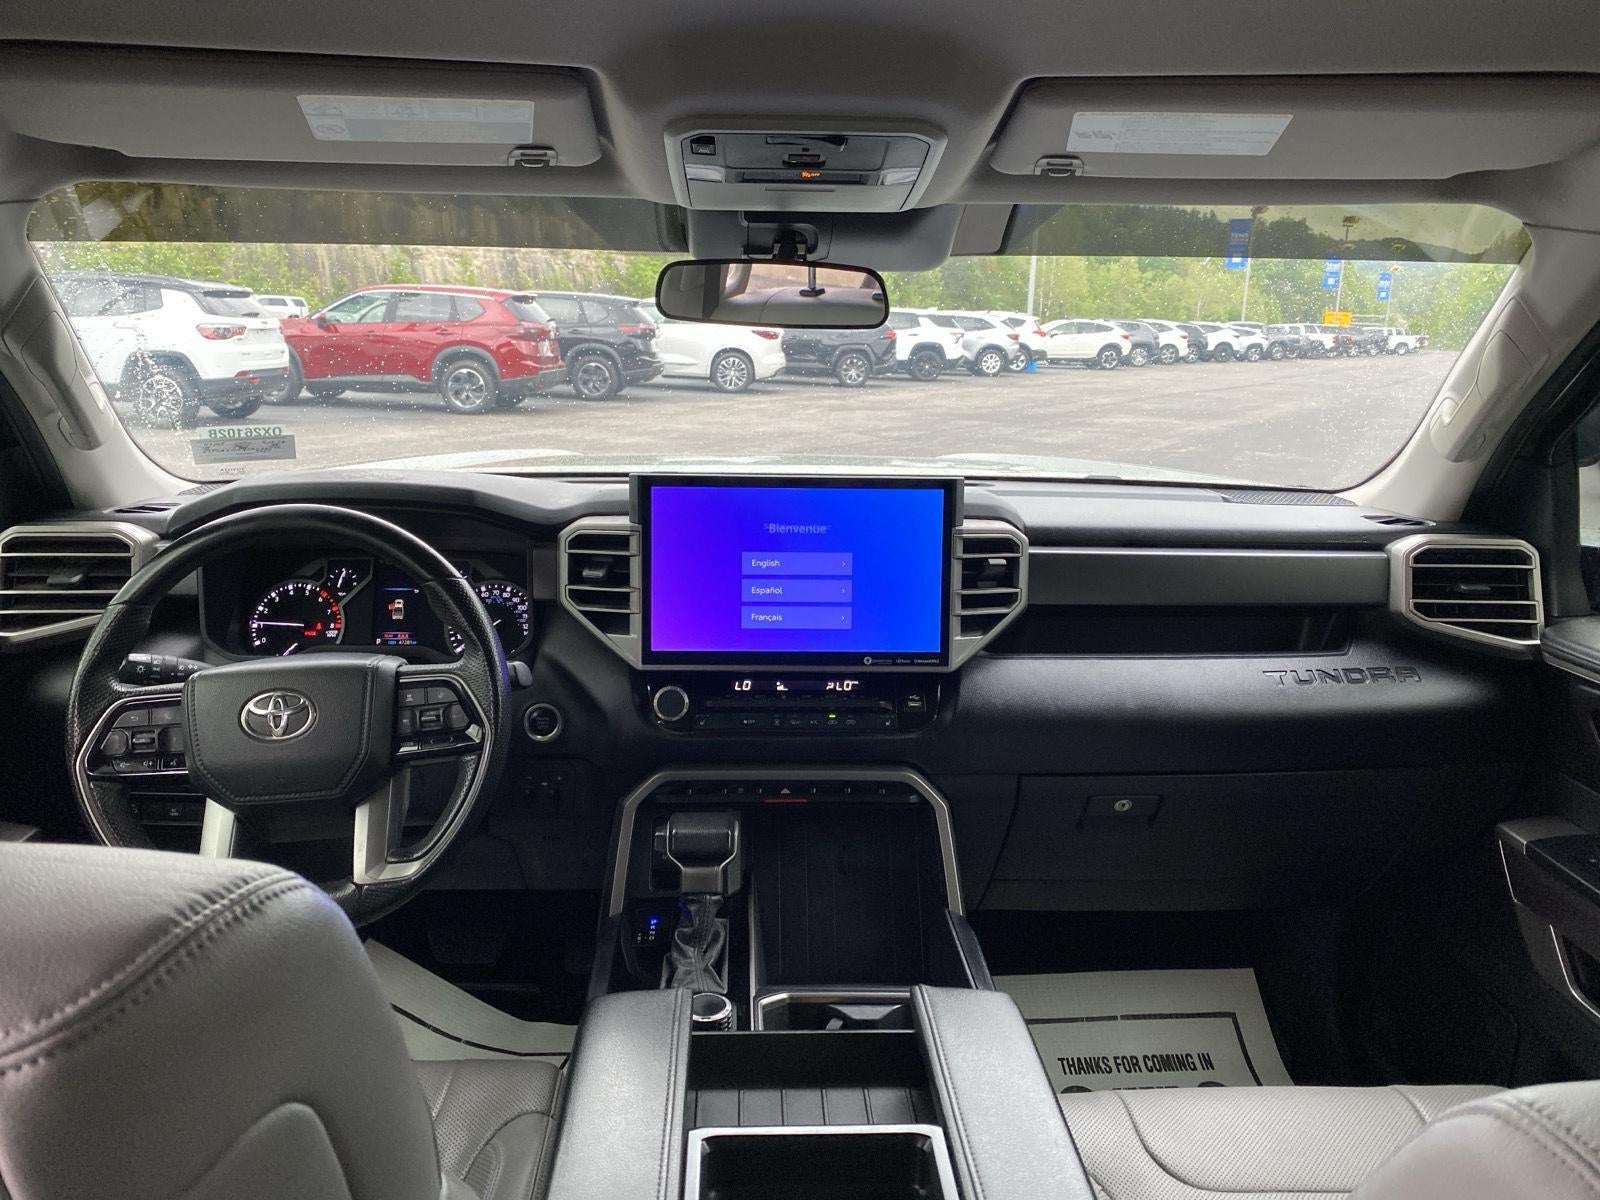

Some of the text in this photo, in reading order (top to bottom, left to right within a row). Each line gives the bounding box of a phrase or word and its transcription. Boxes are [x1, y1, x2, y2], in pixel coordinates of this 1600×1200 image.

[768, 522, 827, 534] Bienvenue
[751, 559, 780, 568] English
[751, 585, 783, 595] Español
[751, 612, 783, 622] Français
[1262, 666, 1422, 687] TUNDRA
[1057, 1052, 1215, 1076] THANKS FOR COMING IN
